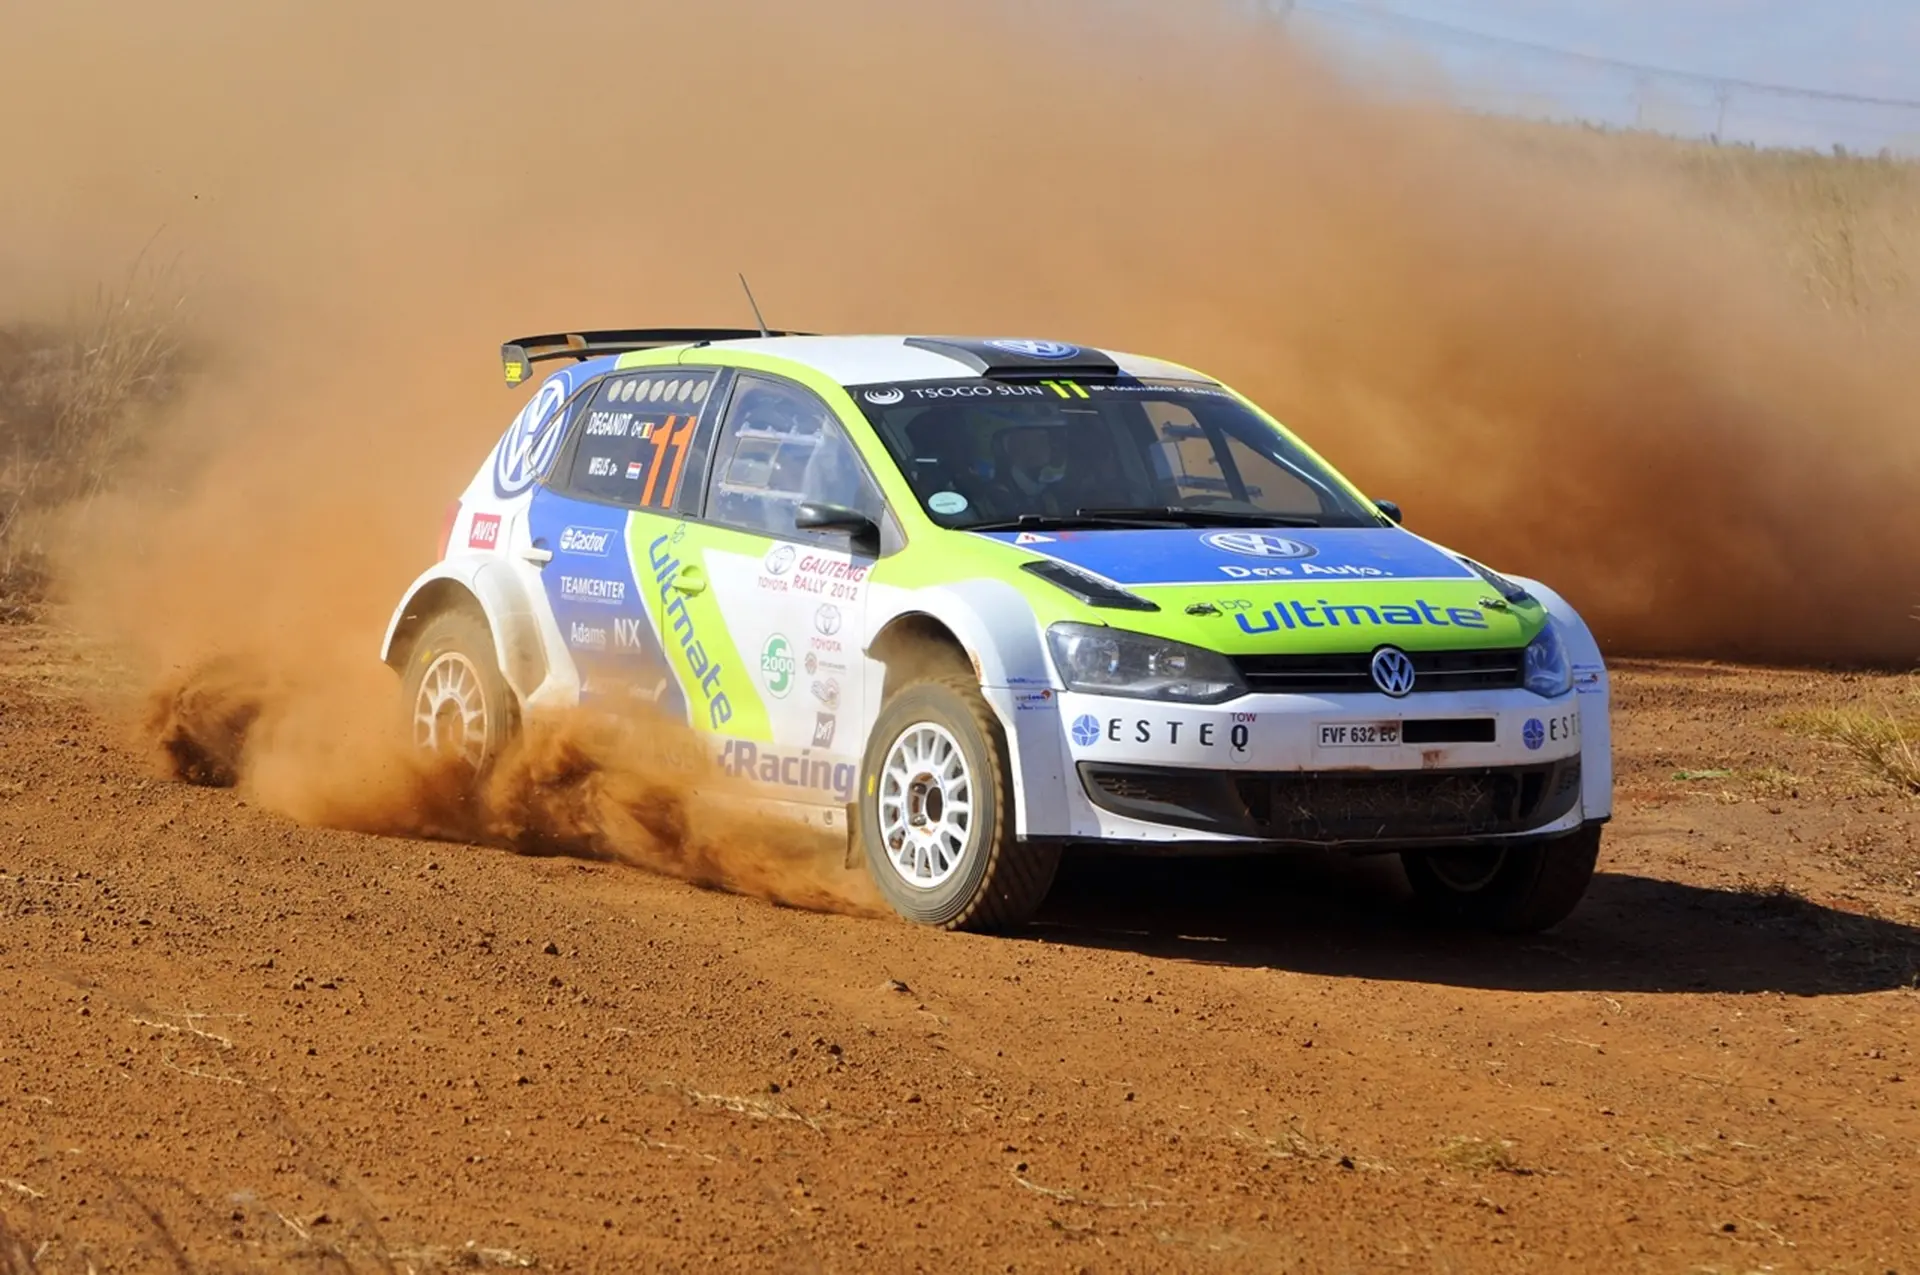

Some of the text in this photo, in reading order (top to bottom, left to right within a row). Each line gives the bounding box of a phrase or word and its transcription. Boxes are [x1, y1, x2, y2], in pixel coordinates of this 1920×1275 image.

[911, 384, 1043, 399] TSOGO SUN
[1040, 380, 1090, 399] 11
[586, 411, 633, 436] DEGANDT
[640, 414, 697, 508] 11
[472, 520, 498, 542] AVIS
[571, 529, 607, 553] Castrol
[799, 555, 867, 583] GAUTENG
[1219, 566, 1293, 578] Das
[561, 576, 625, 599] TEAMCENTER
[758, 576, 788, 592] TOYOTA
[792, 575, 858, 601] RALLY 2012
[1218, 598, 1252, 616] bp
[1235, 599, 1489, 635] ultimate
[571, 618, 641, 648] Adams NX
[811, 637, 842, 652] TOYOTA
[762, 655, 794, 672] 2000
[1231, 713, 1256, 722] TOW
[1107, 718, 1249, 752] ESTEQ
[1322, 727, 1346, 743] FVF
[1351, 727, 1375, 742] 632
